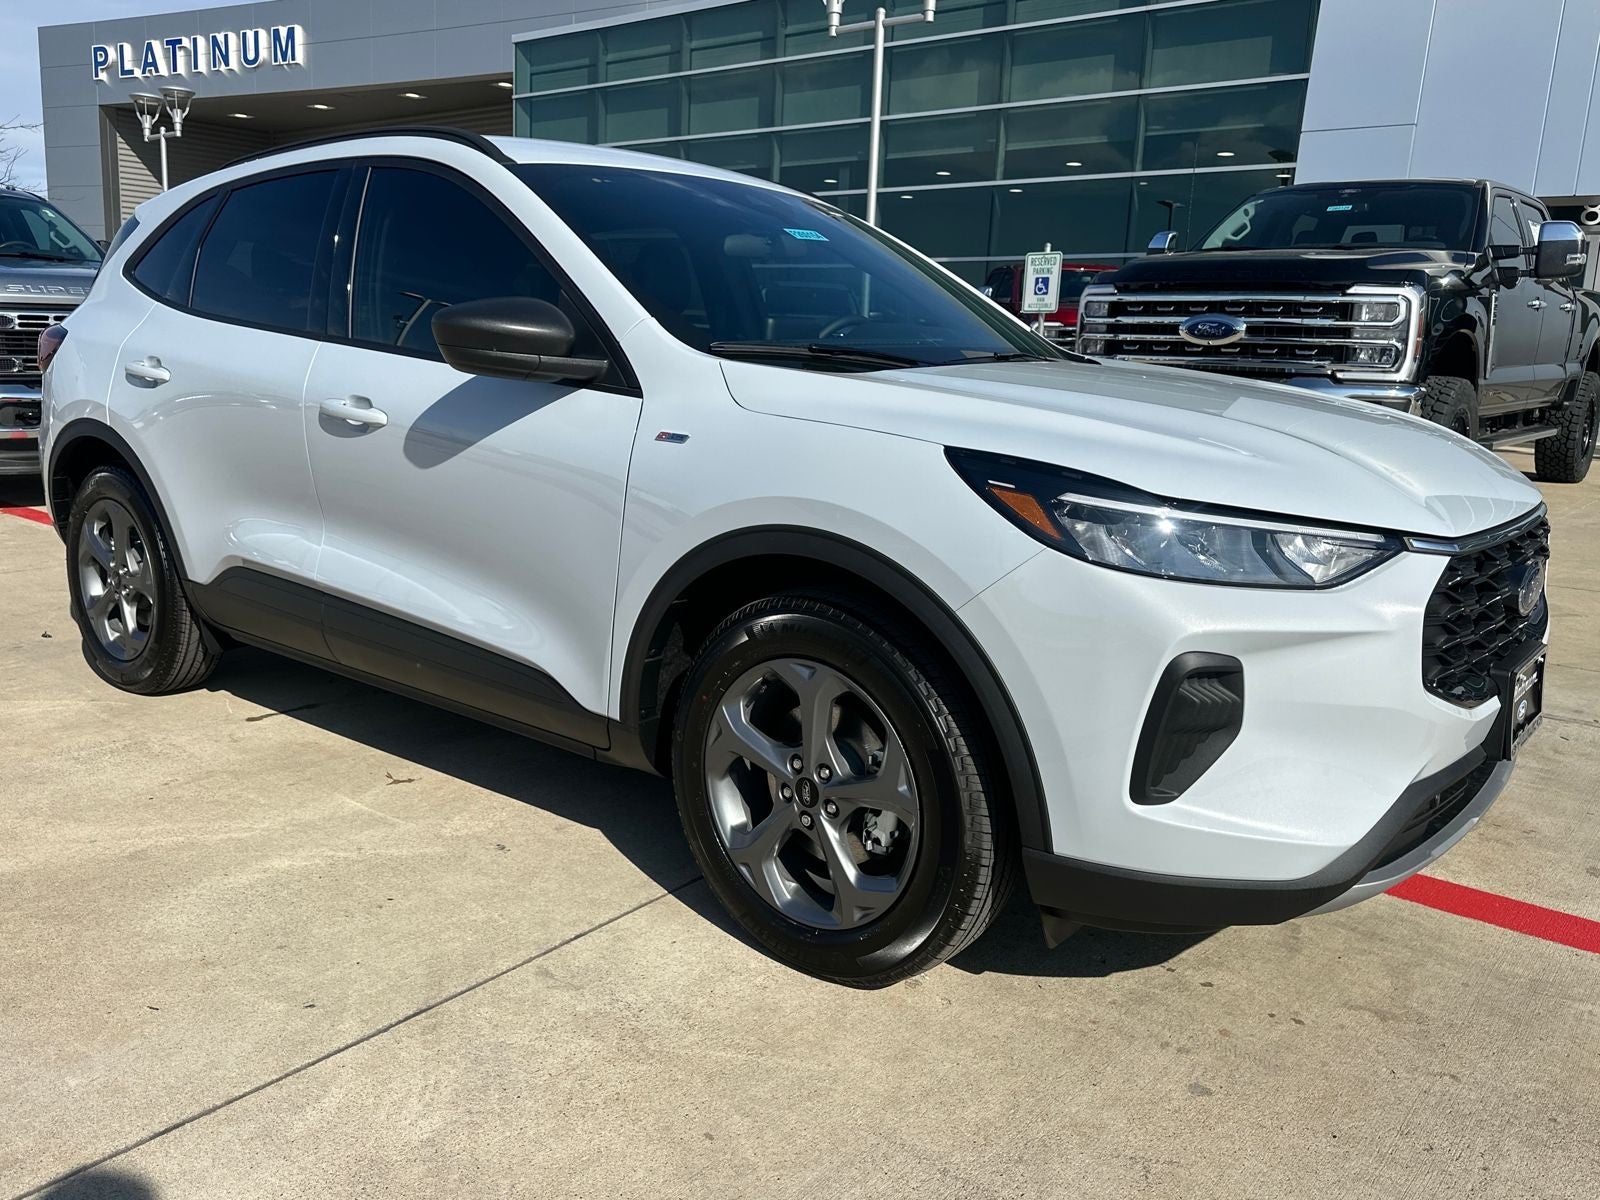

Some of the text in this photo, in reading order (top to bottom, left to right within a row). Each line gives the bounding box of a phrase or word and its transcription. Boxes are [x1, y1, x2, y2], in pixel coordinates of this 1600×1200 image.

[92, 25, 301, 81] PLATINUM
[1030, 256, 1057, 267] RESERVED
[1032, 267, 1053, 275] PARKING
[6, 284, 91, 296] SUPE
